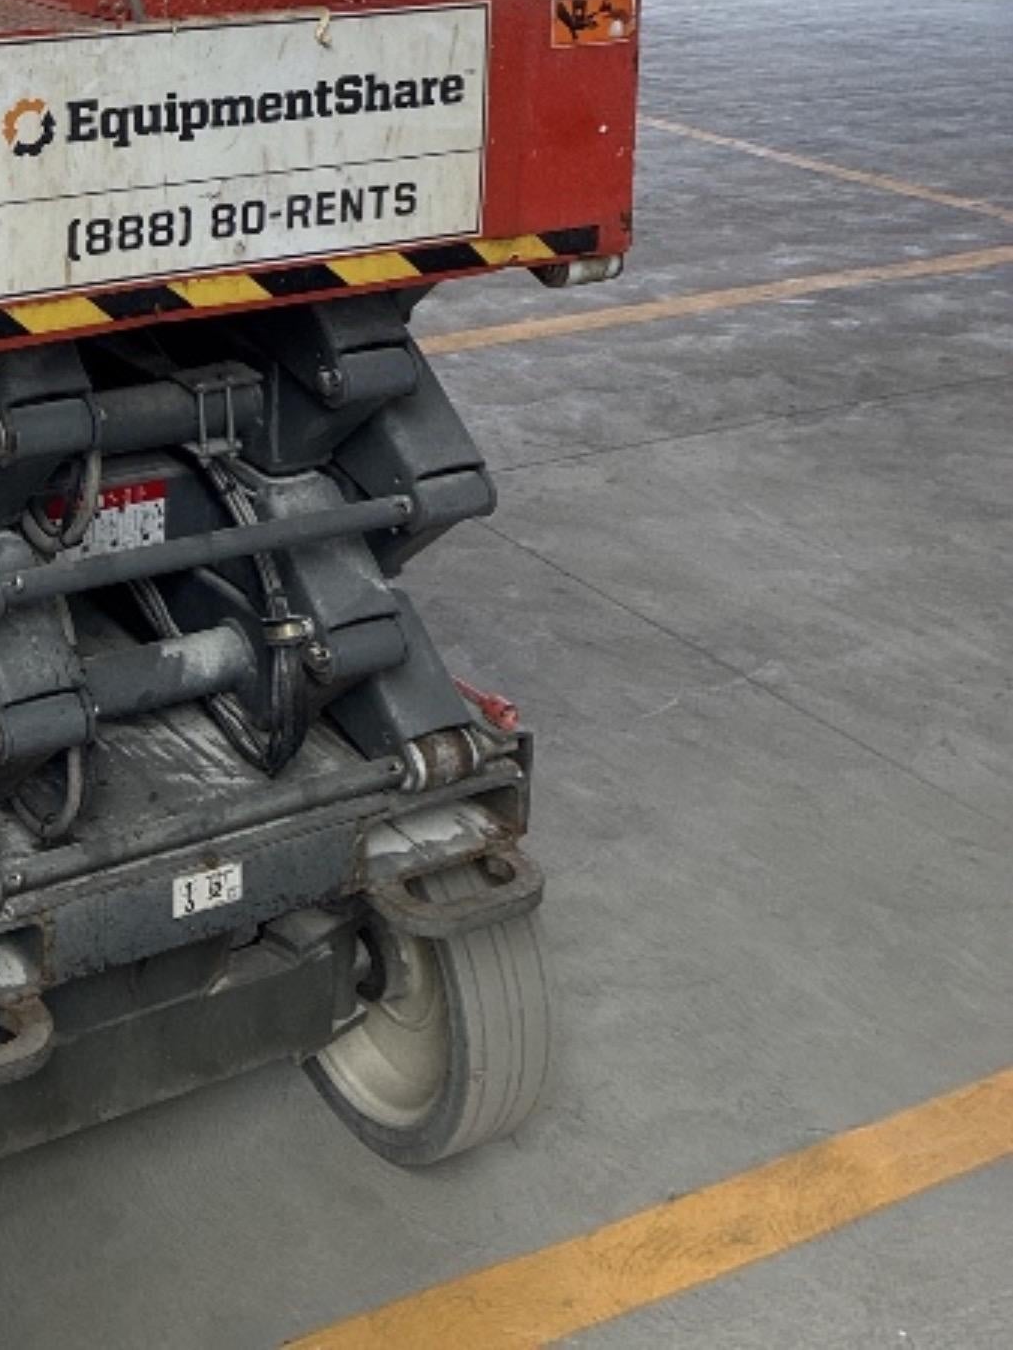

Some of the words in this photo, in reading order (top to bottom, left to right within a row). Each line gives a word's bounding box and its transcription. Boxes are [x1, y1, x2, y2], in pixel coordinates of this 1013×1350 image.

[65, 73, 465, 148] EquipmentShare
[67, 206, 192, 262] (888)
[210, 182, 418, 239] 80-RENTS
